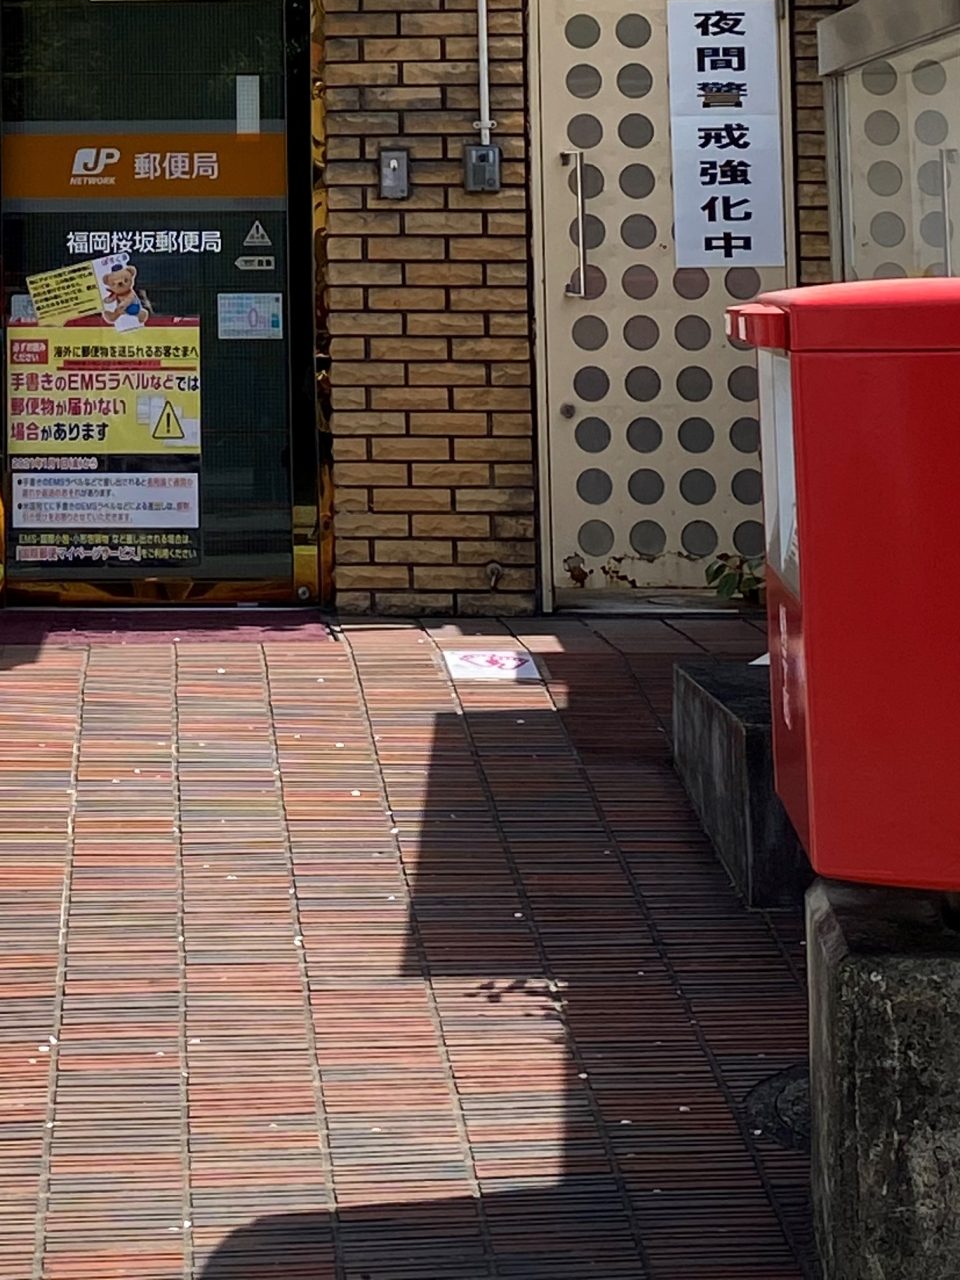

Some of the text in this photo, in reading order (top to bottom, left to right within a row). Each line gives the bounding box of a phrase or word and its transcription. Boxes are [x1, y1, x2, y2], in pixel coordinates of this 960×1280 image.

[694, 11, 753, 258] 夜間警戒強化中
[134, 152, 219, 180] 郵便局
[69, 176, 116, 185] NETWORK
[66, 231, 222, 254] 福岡桜坂郵便局
[53, 345, 199, 358] 海外に郵便物を送られるお客さまへ
[11, 372, 200, 391] 手書きのEMSラベルなどでは
[11, 397, 127, 417] 郵便物が届かない
[11, 422, 109, 441] 場合があります
